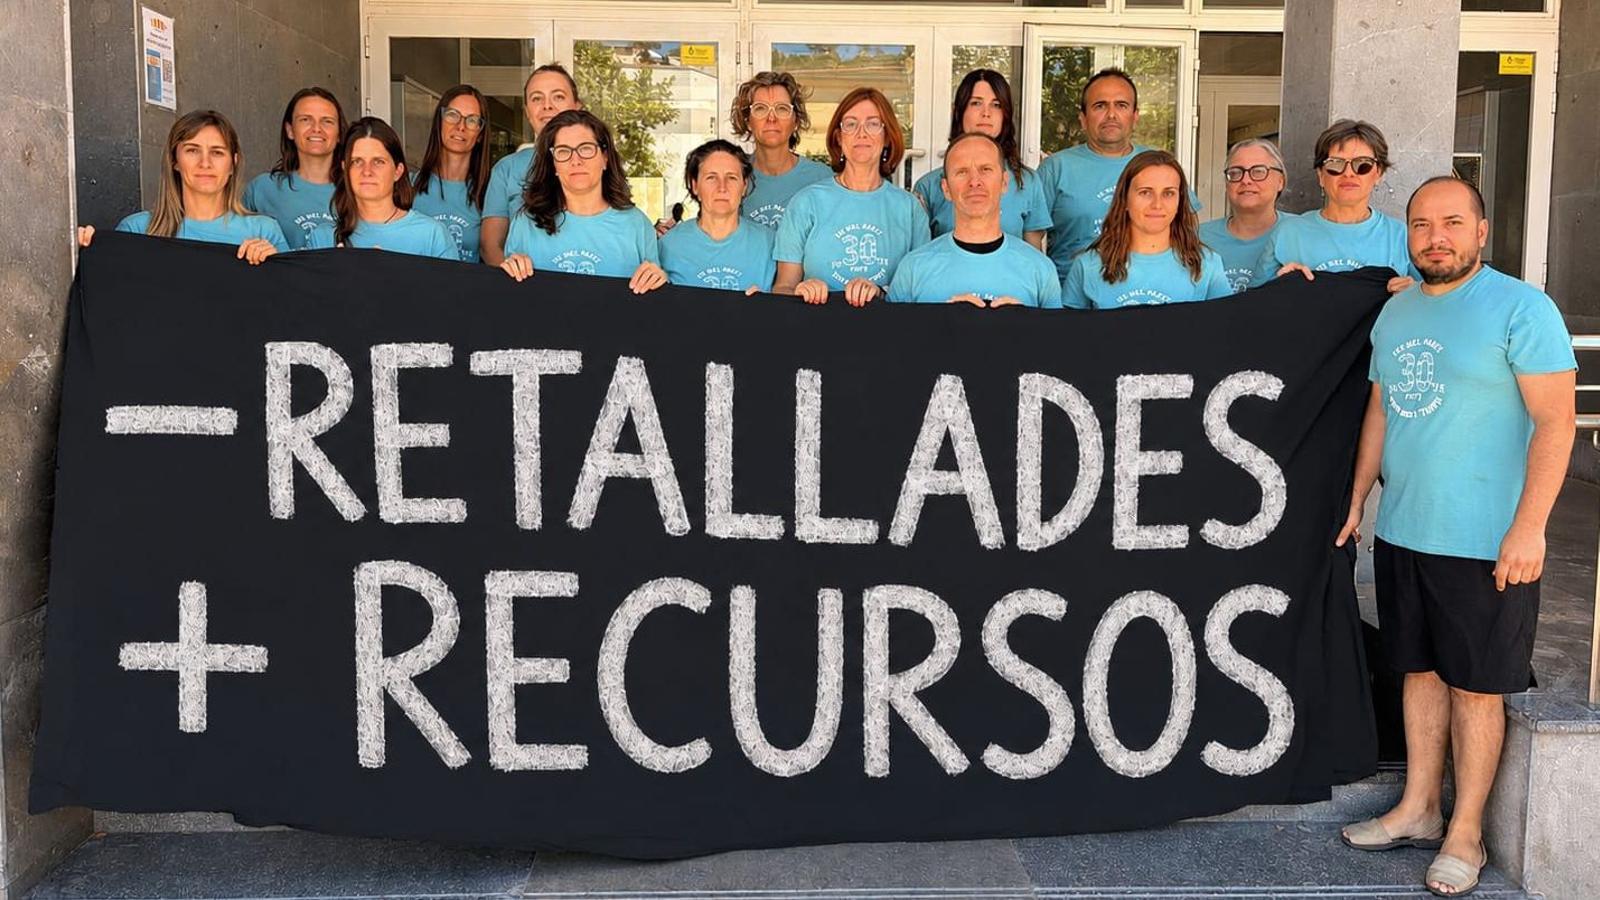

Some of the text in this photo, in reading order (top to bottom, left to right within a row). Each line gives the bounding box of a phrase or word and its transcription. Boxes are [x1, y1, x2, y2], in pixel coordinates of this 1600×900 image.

[841, 233, 877, 266] 30
[1398, 351, 1434, 393] 30
[265, 342, 1287, 552] RETALLADES
[353, 560, 1294, 779] RECURSOS
